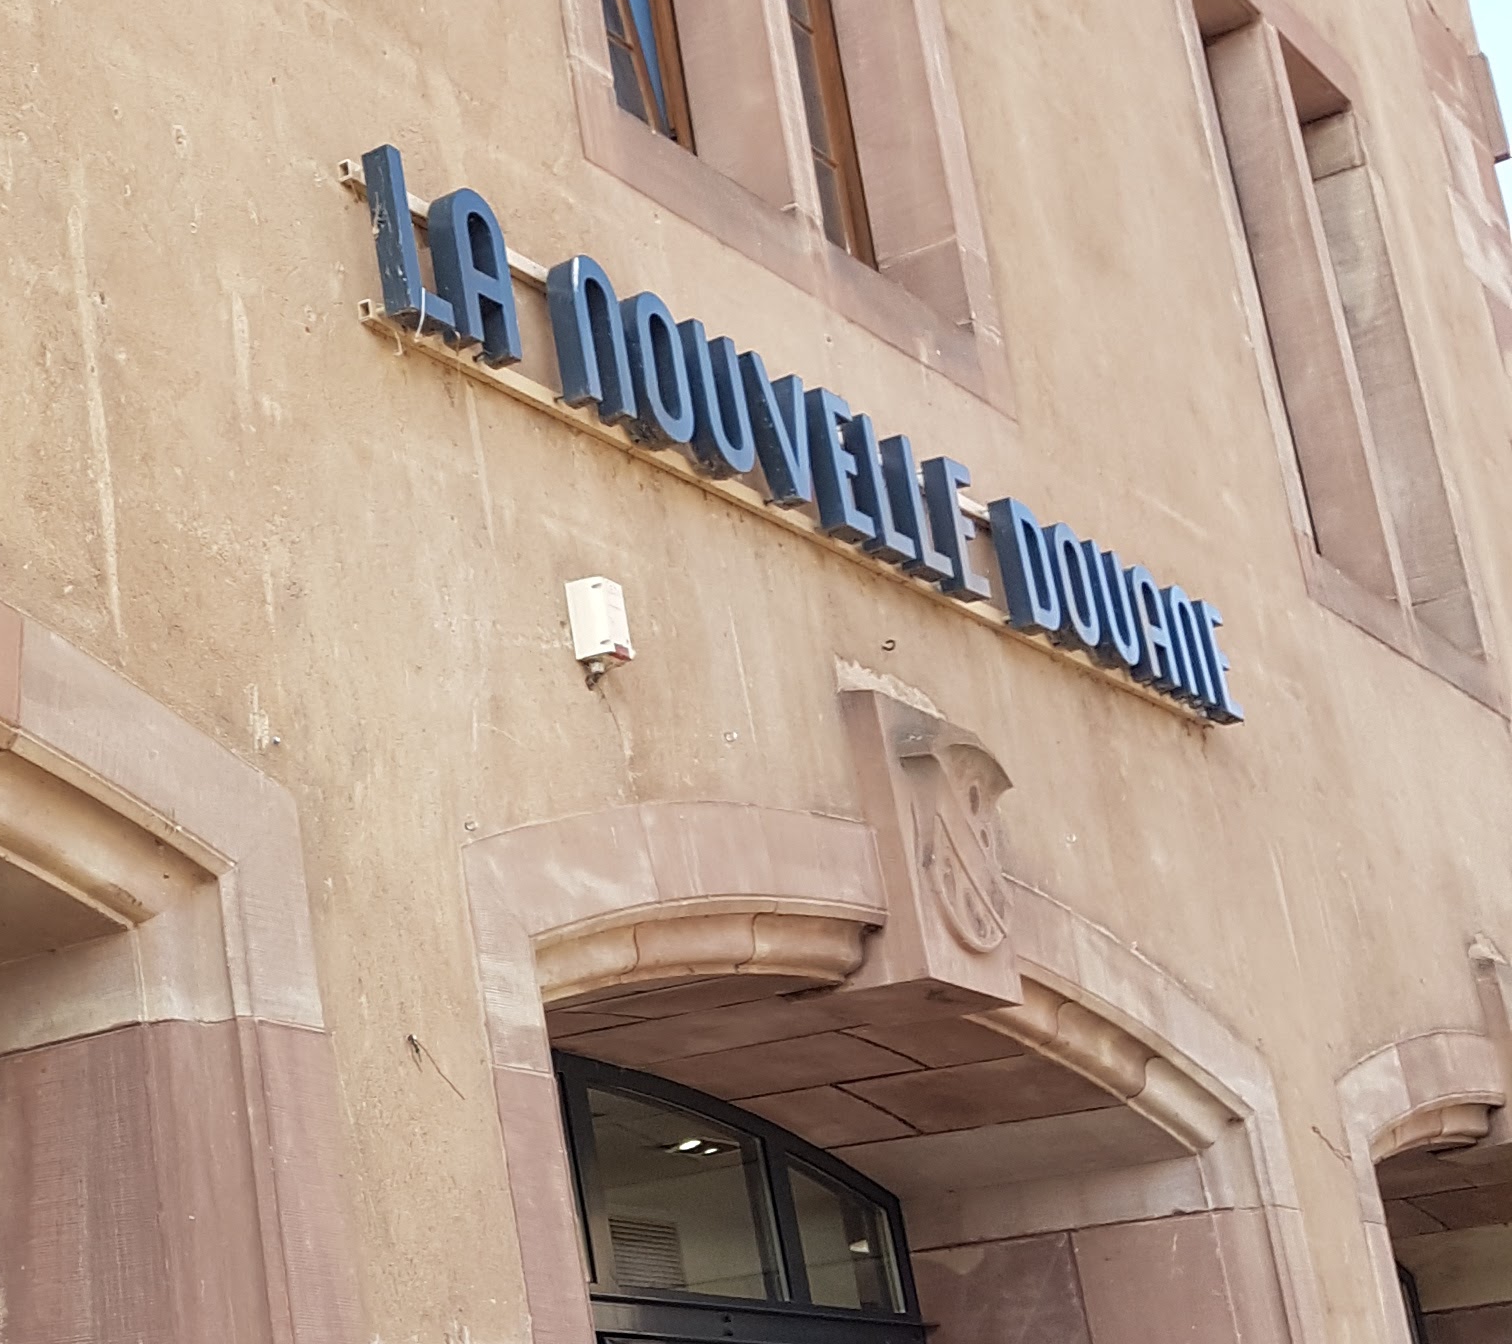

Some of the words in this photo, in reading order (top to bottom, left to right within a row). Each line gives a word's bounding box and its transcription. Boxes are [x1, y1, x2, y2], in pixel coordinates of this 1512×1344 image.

[362, 144, 522, 368] LA
[546, 255, 990, 601] NOUVELLE
[988, 496, 1244, 726] DOUANE
